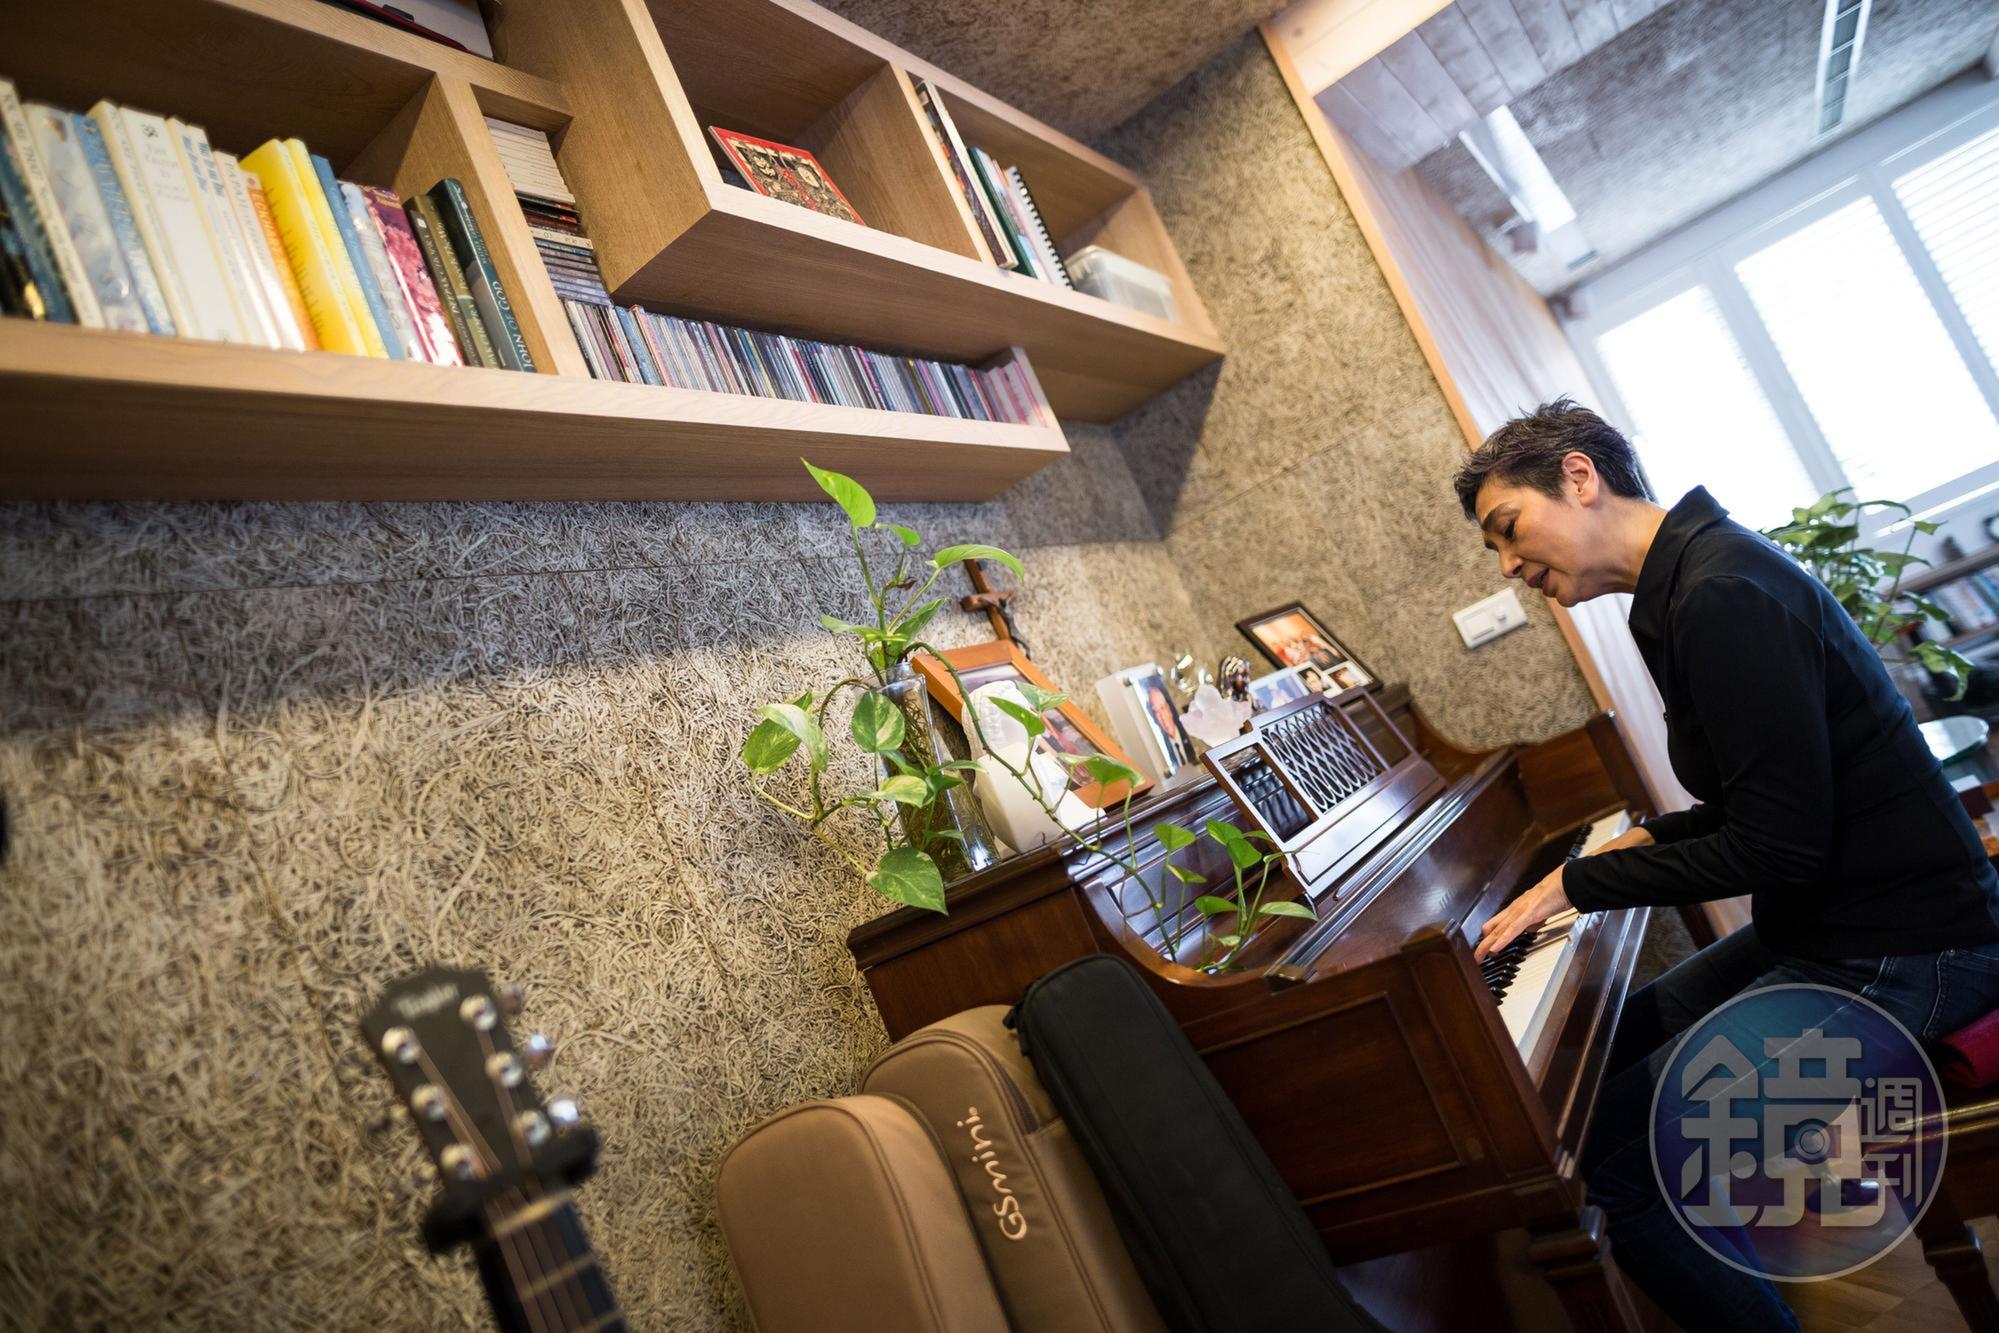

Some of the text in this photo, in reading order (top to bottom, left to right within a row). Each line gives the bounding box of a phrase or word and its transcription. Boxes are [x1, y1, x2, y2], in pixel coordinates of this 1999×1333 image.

[492, 280, 535, 368] JOHN OF GOD
